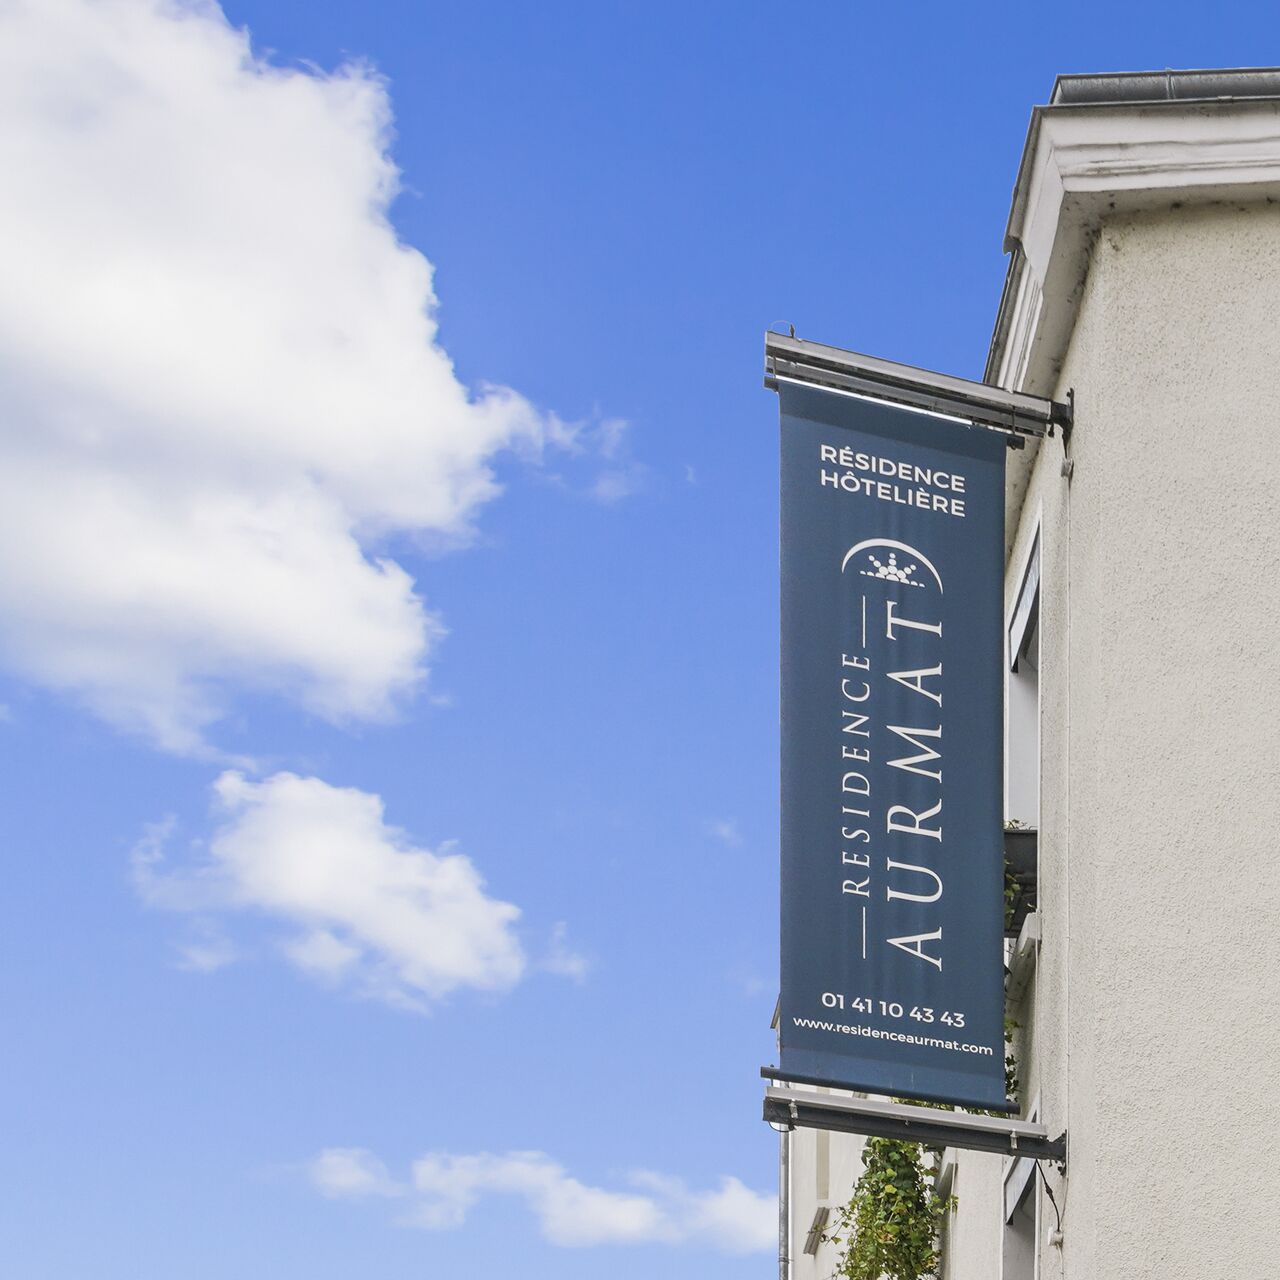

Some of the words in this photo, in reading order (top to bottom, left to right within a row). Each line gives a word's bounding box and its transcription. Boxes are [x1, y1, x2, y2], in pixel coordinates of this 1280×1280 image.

[820, 444, 966, 493] RÉSIDENCE
[820, 469, 966, 518] HÔTELIÈRE
[842, 653, 870, 898] RESIDENCE
[886, 600, 943, 972] AURMAT
[821, 992, 844, 1009] 01
[851, 997, 873, 1014] 41
[879, 1001, 904, 1018] 10
[909, 1006, 935, 1023] 43
[940, 1011, 966, 1028] 43
[793, 1017, 994, 1056] www.residenceaurmat.com
